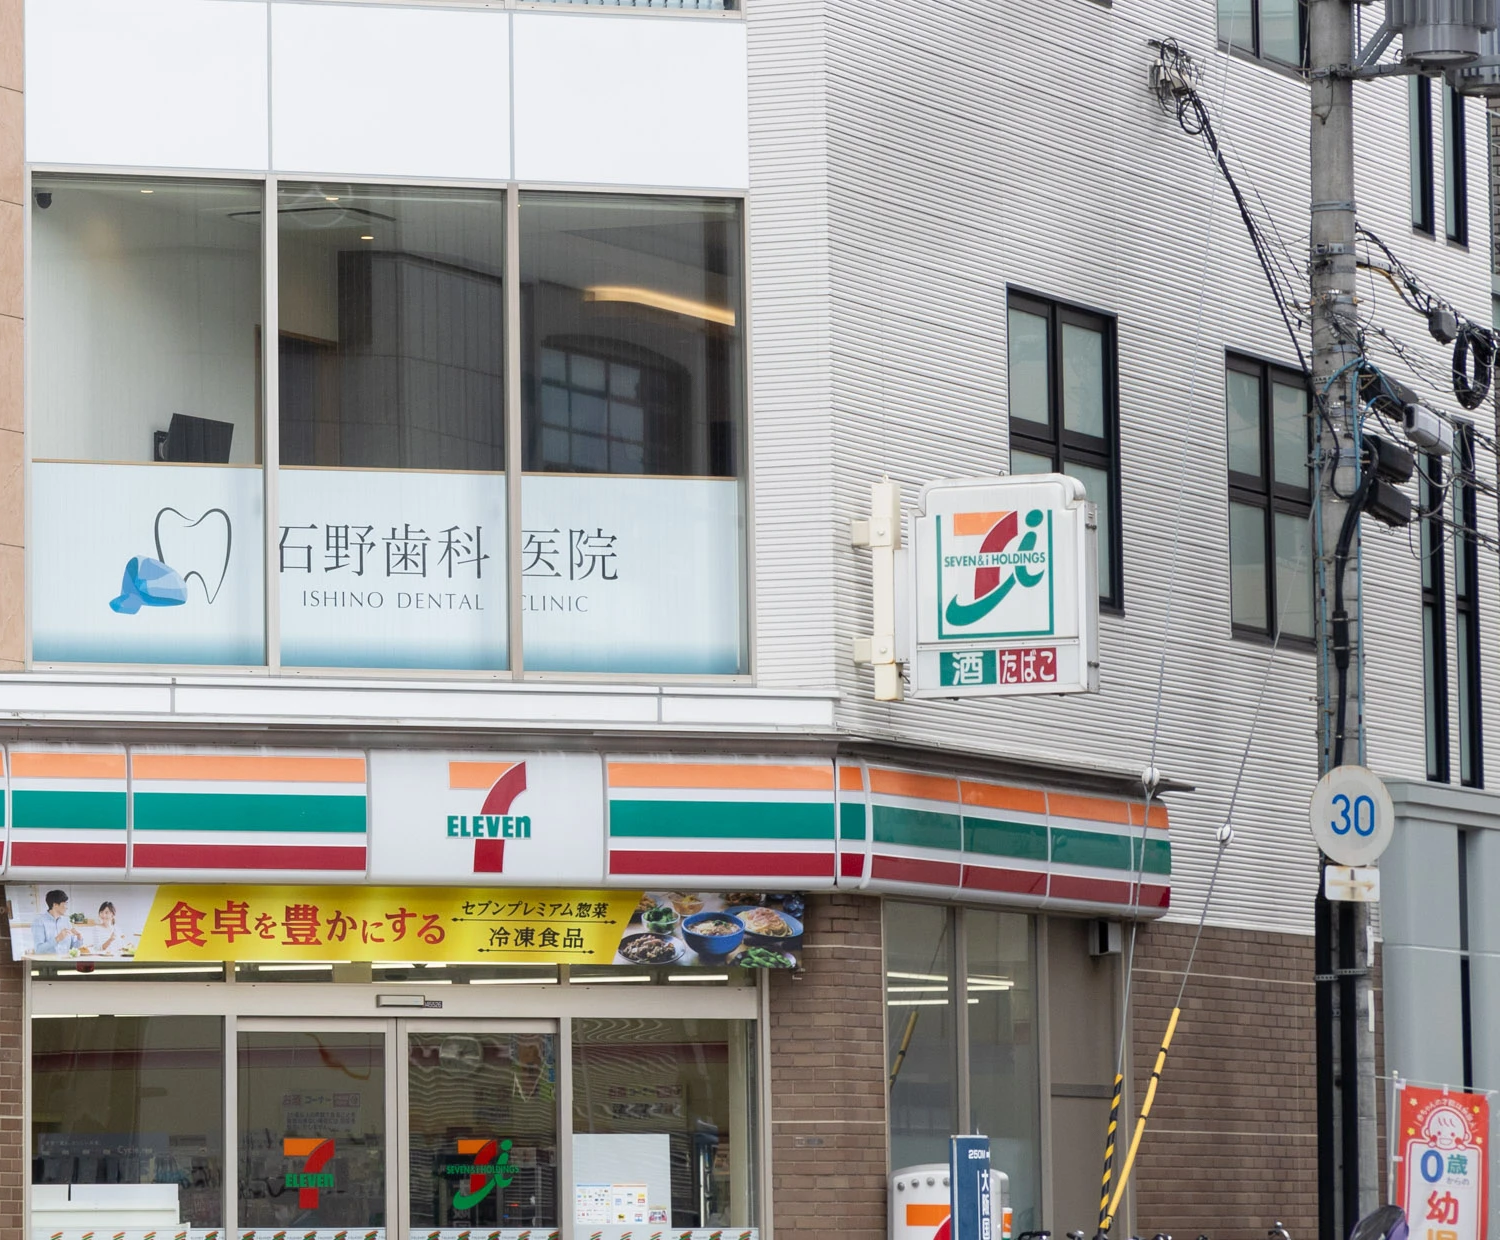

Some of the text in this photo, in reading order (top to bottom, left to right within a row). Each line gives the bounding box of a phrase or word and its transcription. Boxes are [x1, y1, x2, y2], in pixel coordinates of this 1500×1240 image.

[991, 551, 1046, 565] HOLDINGS
[303, 590, 589, 613] ISHINO DENTAL CLINIC
[951, 649, 1055, 686] 酒 たばこ
[1330, 793, 1375, 837] 30
[462, 900, 610, 919] セブンプレミアム惣菜
[160, 900, 446, 949] 食卓を豊かにする
[488, 926, 585, 949] 冷凍食品
[480, 1164, 520, 1175] HOLDINGS
